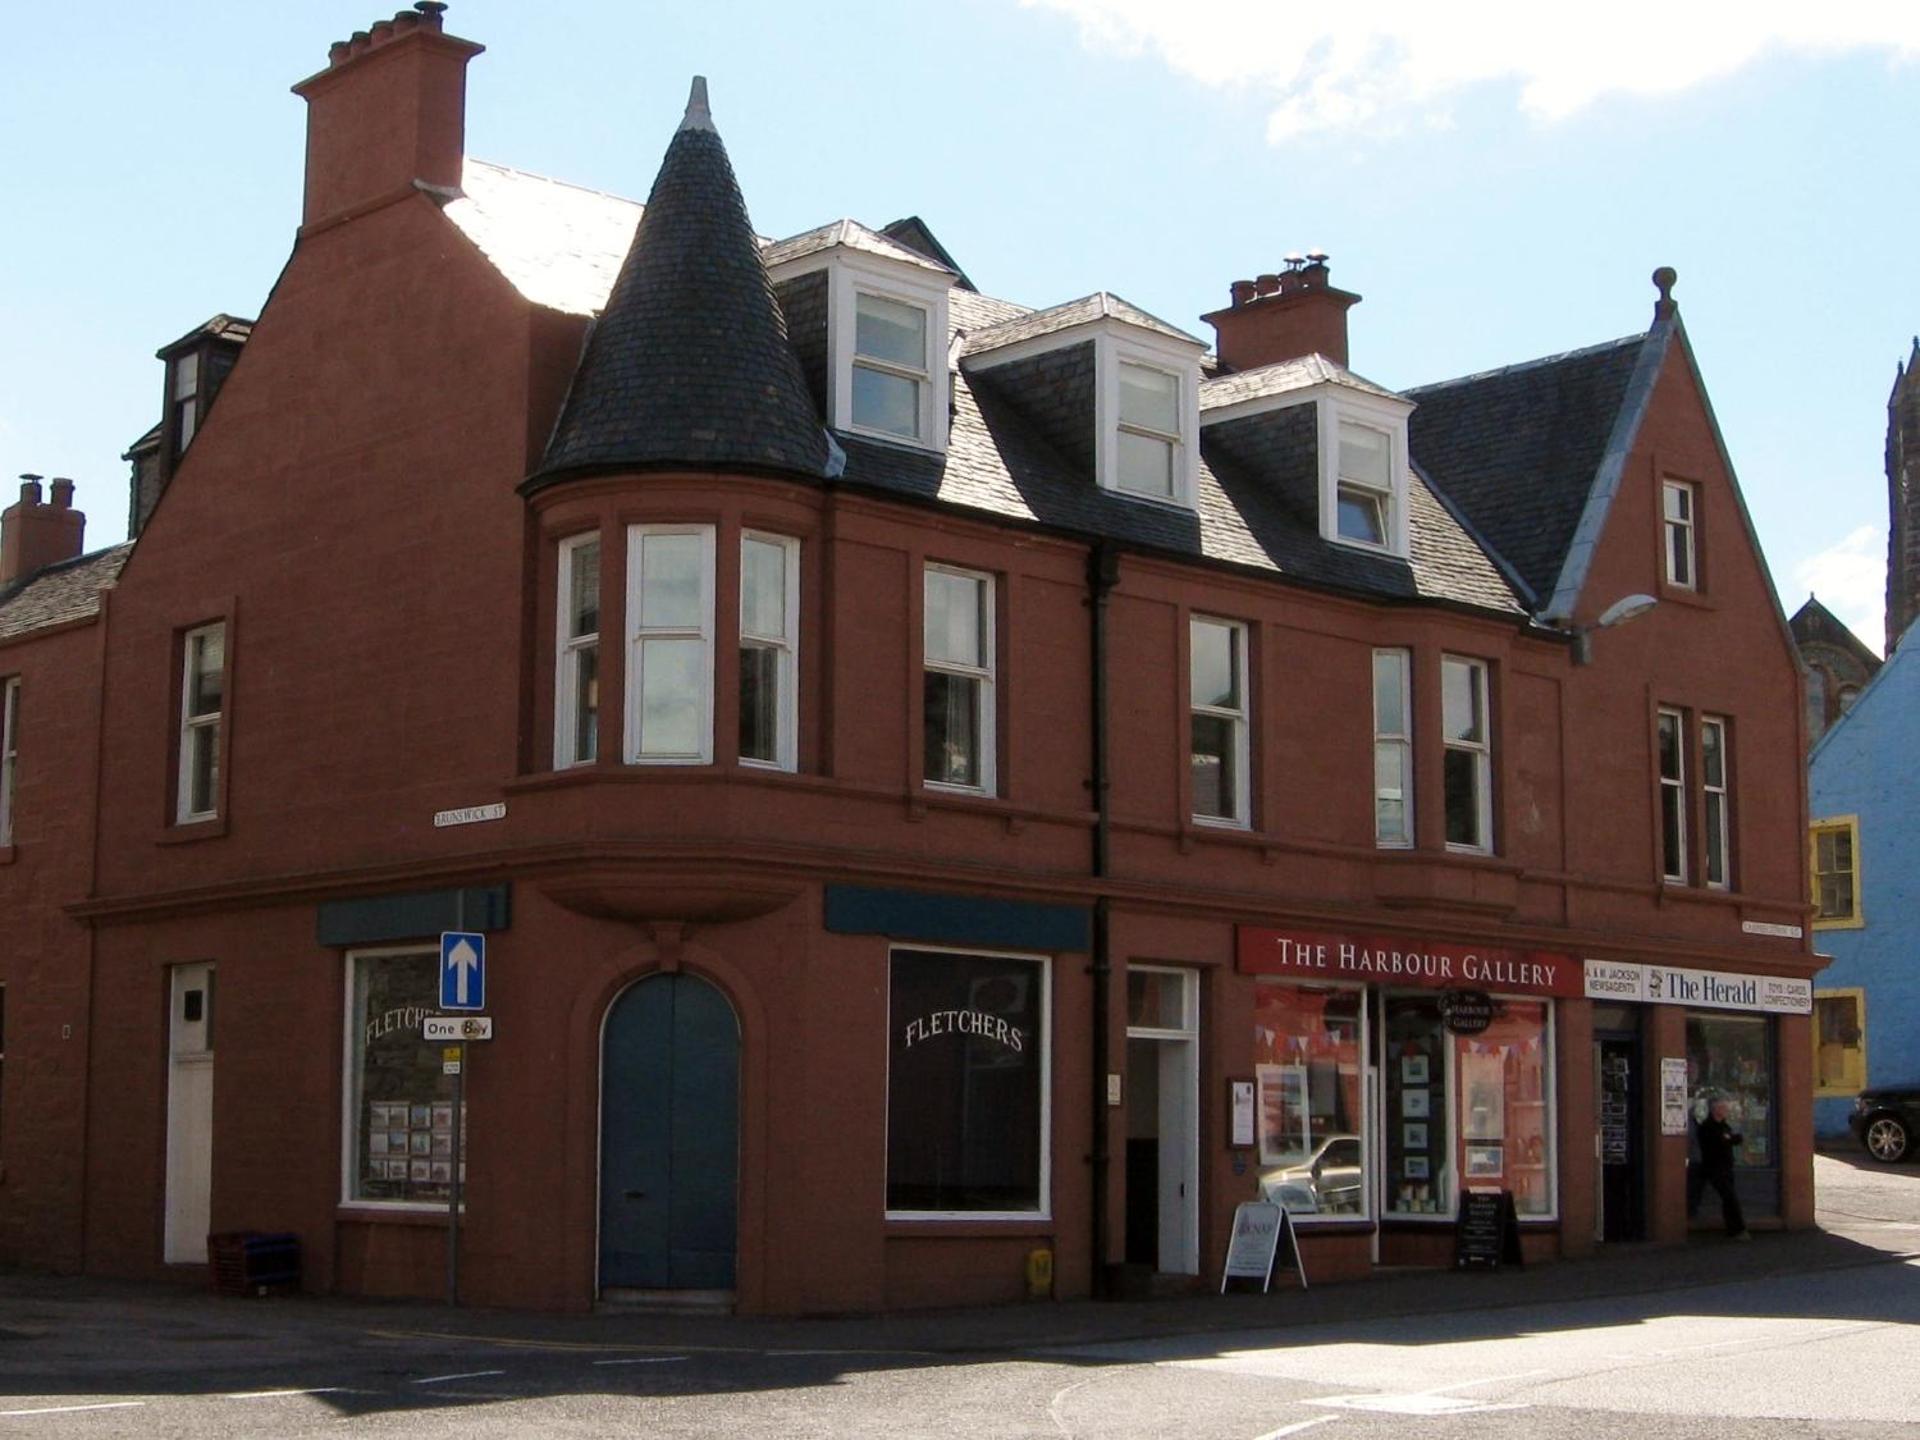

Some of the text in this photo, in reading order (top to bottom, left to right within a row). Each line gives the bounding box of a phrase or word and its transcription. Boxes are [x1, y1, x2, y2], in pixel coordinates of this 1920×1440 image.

[493, 804, 503, 819] ST
[1278, 938, 1556, 986] THE HARBOUR GALLERY
[1608, 970, 1640, 980] JACKSON
[1589, 981, 1635, 993] NEWSAGENTS
[1666, 973, 1756, 1004] The Herald
[428, 1023, 455, 1035] One
[906, 1009, 1022, 1052] FLETCHERS
